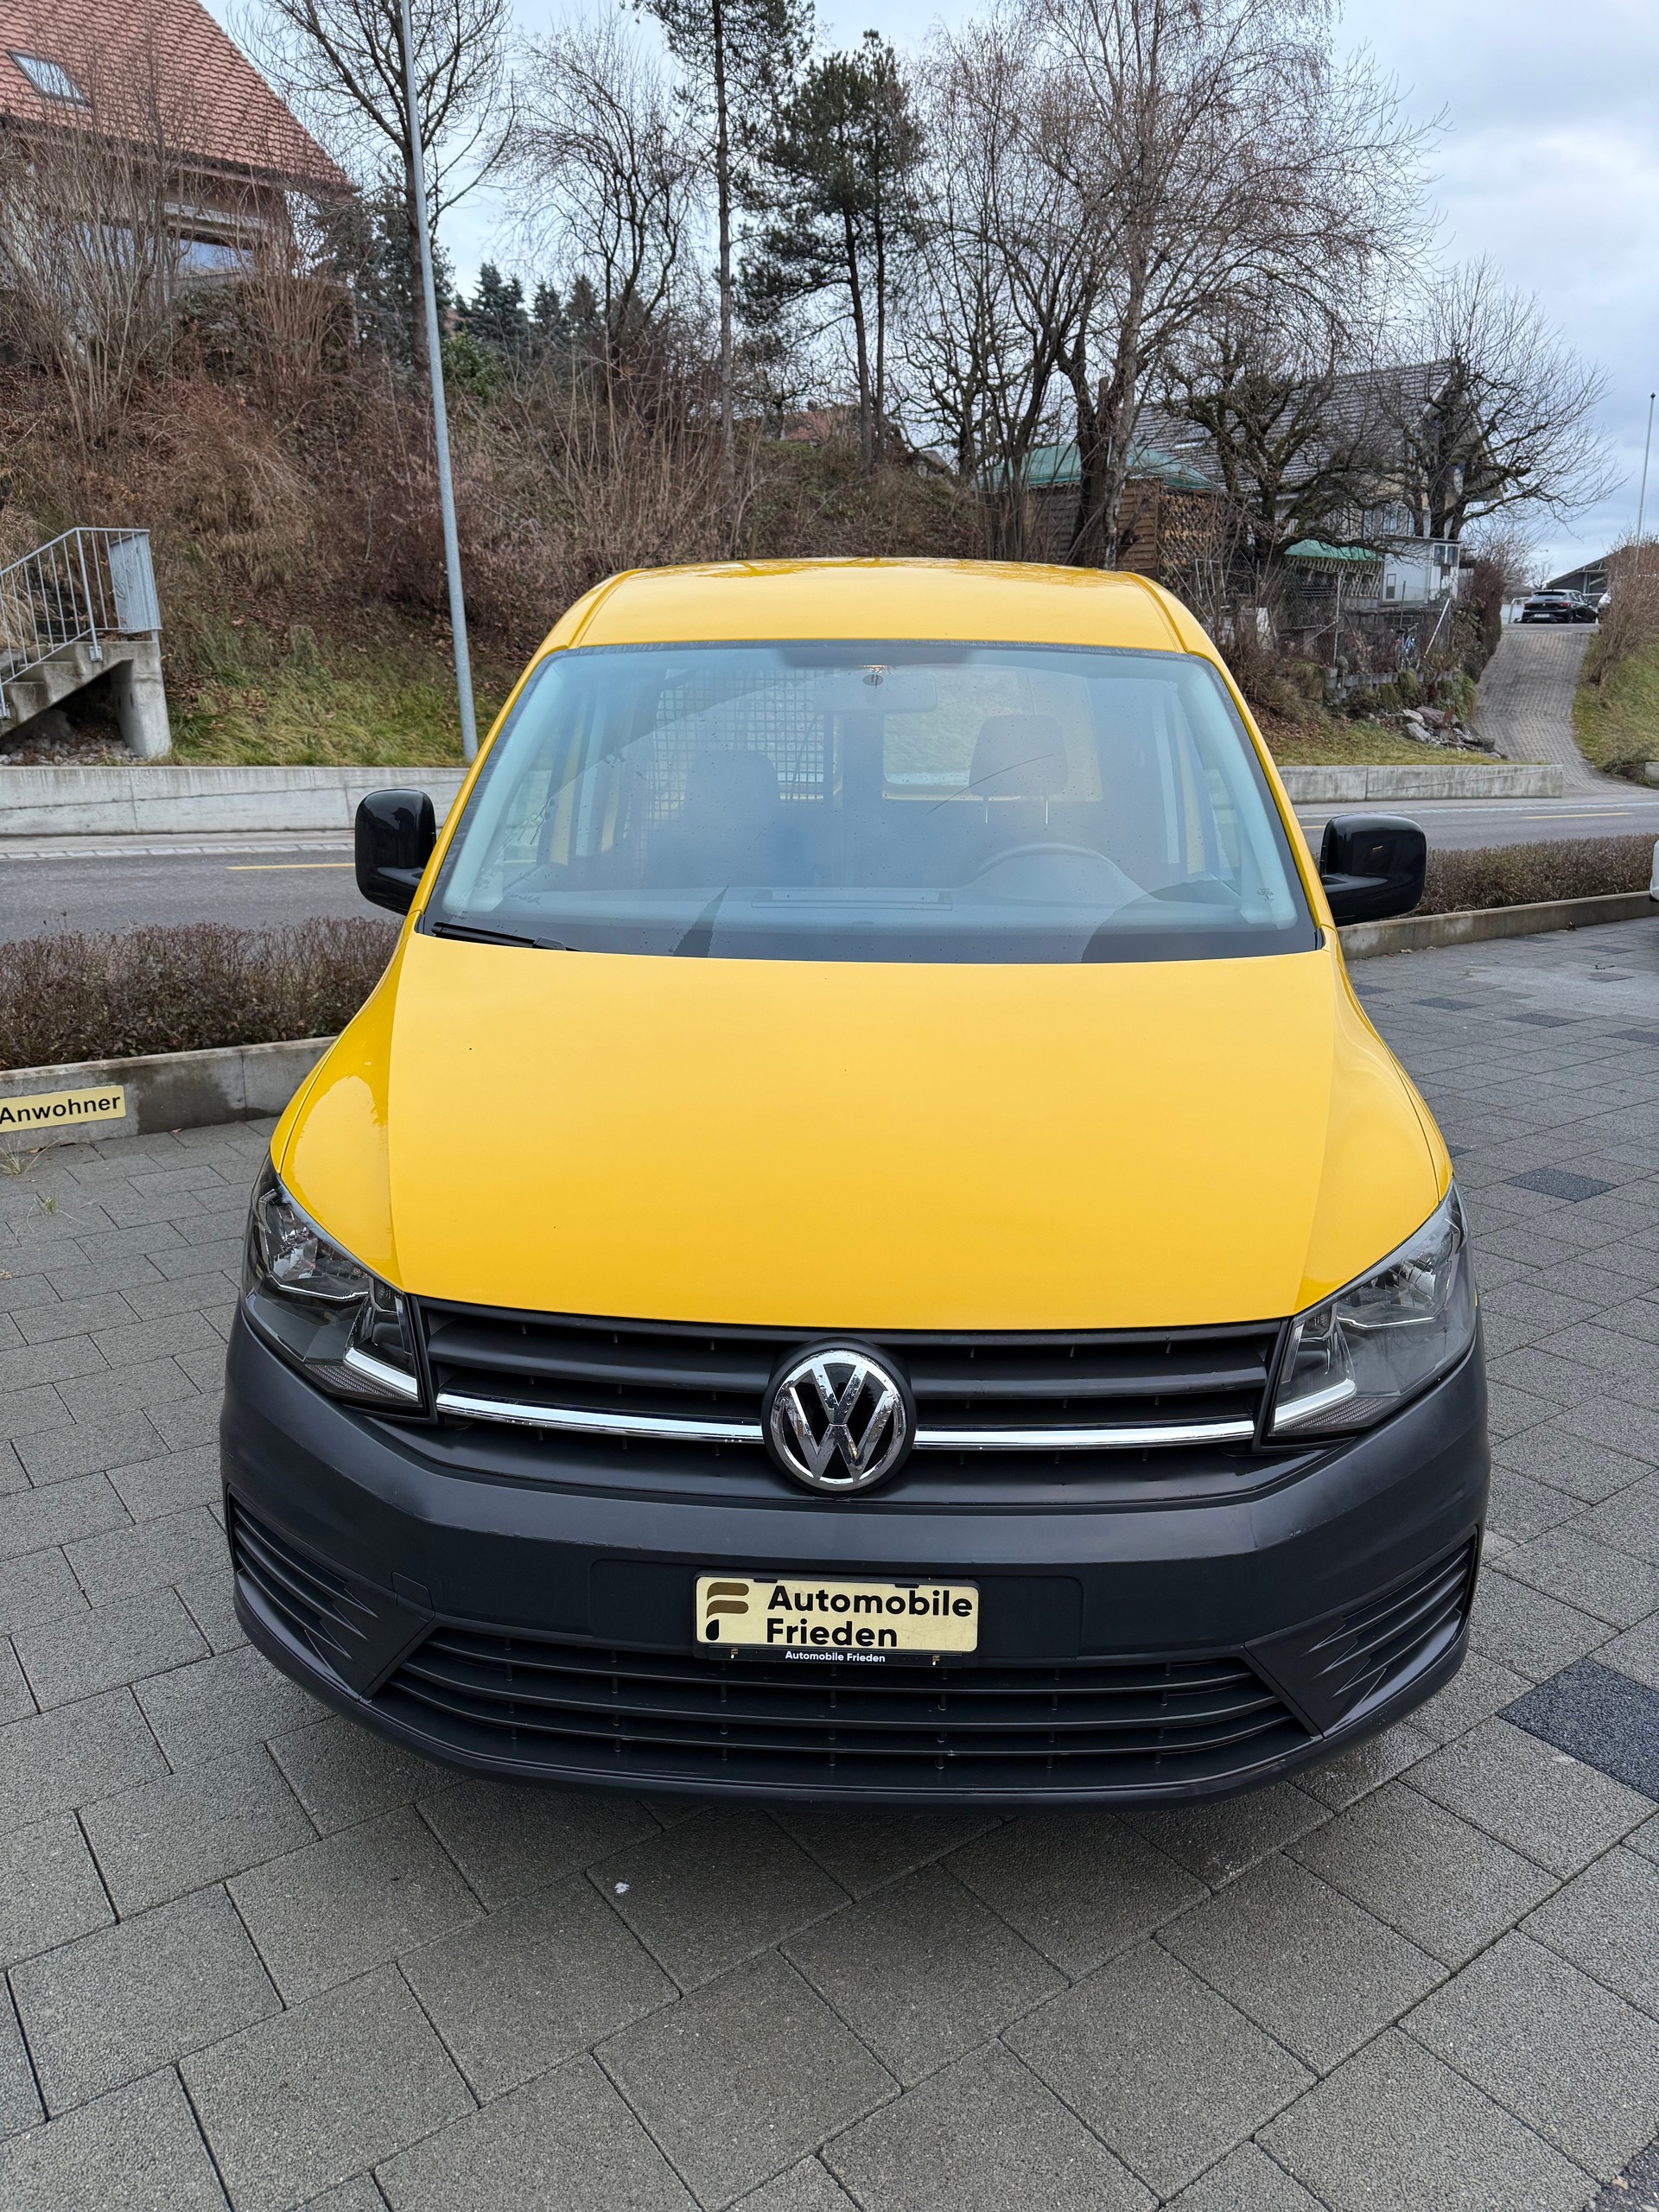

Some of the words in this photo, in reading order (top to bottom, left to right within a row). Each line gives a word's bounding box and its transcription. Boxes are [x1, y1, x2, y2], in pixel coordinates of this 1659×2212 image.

[0, 1096, 121, 1123] Anwohner
[767, 1585, 973, 1618] Automobile
[766, 1618, 898, 1648] Frieden
[785, 1650, 844, 1662] Automobile
[846, 1652, 886, 1663] Frieden
